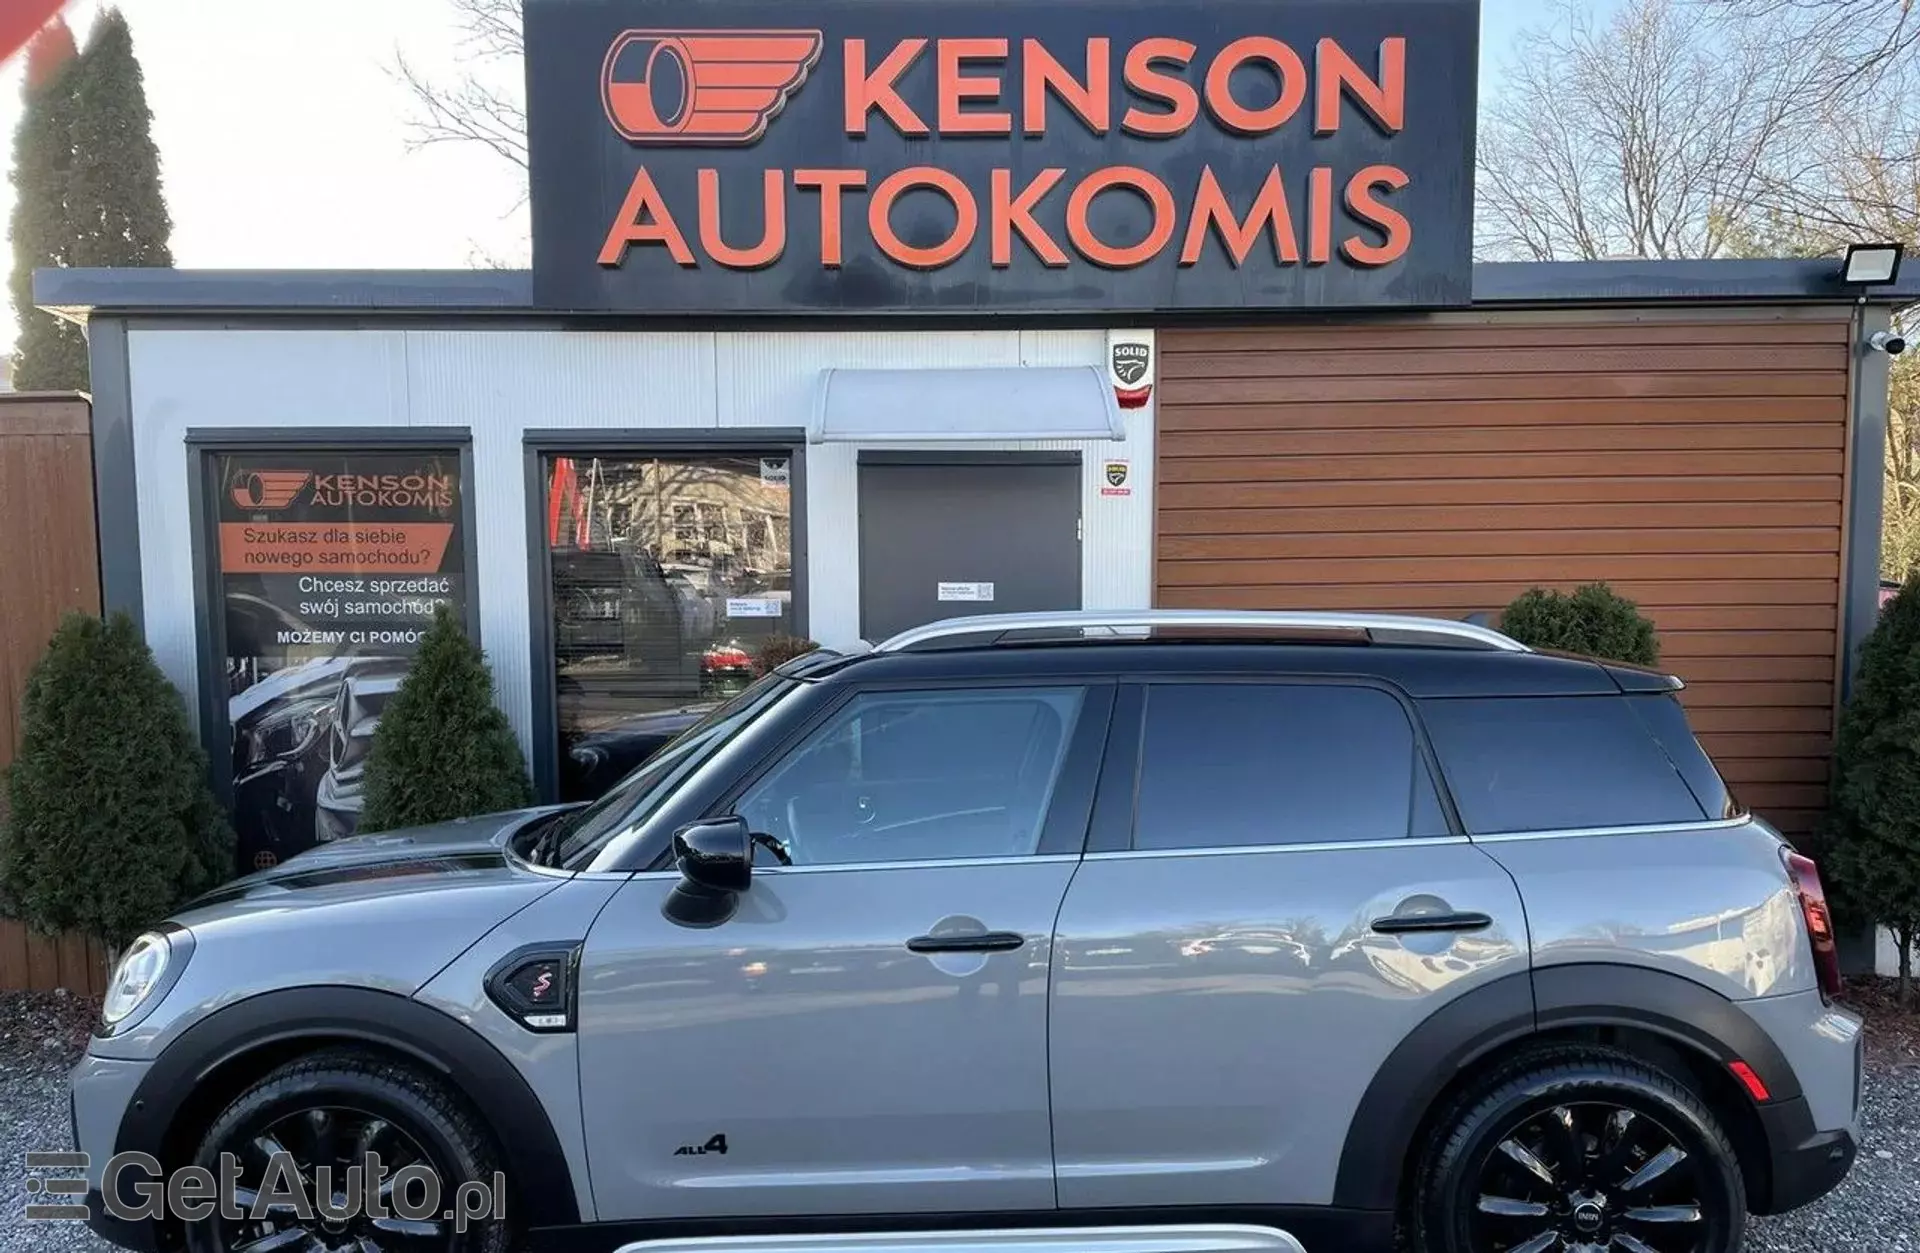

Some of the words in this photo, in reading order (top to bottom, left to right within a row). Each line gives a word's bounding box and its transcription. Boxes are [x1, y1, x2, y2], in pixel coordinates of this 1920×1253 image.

[845, 36, 1406, 137] KENSON
[597, 164, 1412, 269] AUTOKOMIS
[1115, 346, 1148, 357] SOLID
[314, 474, 449, 490] KENSON
[310, 490, 453, 507] AUTOKOMIS
[244, 527, 318, 544] Szukasz
[323, 528, 349, 543] dla
[355, 528, 406, 543] siebie
[244, 551, 313, 567] nowego
[318, 549, 431, 565] samochodu?
[299, 576, 365, 593] Chcesz
[370, 577, 449, 596] sprzedać
[300, 599, 339, 618] swój
[277, 628, 345, 644] MOŻEMY
[350, 631, 365, 643] CI
[673, 1133, 728, 1155] ALL4
